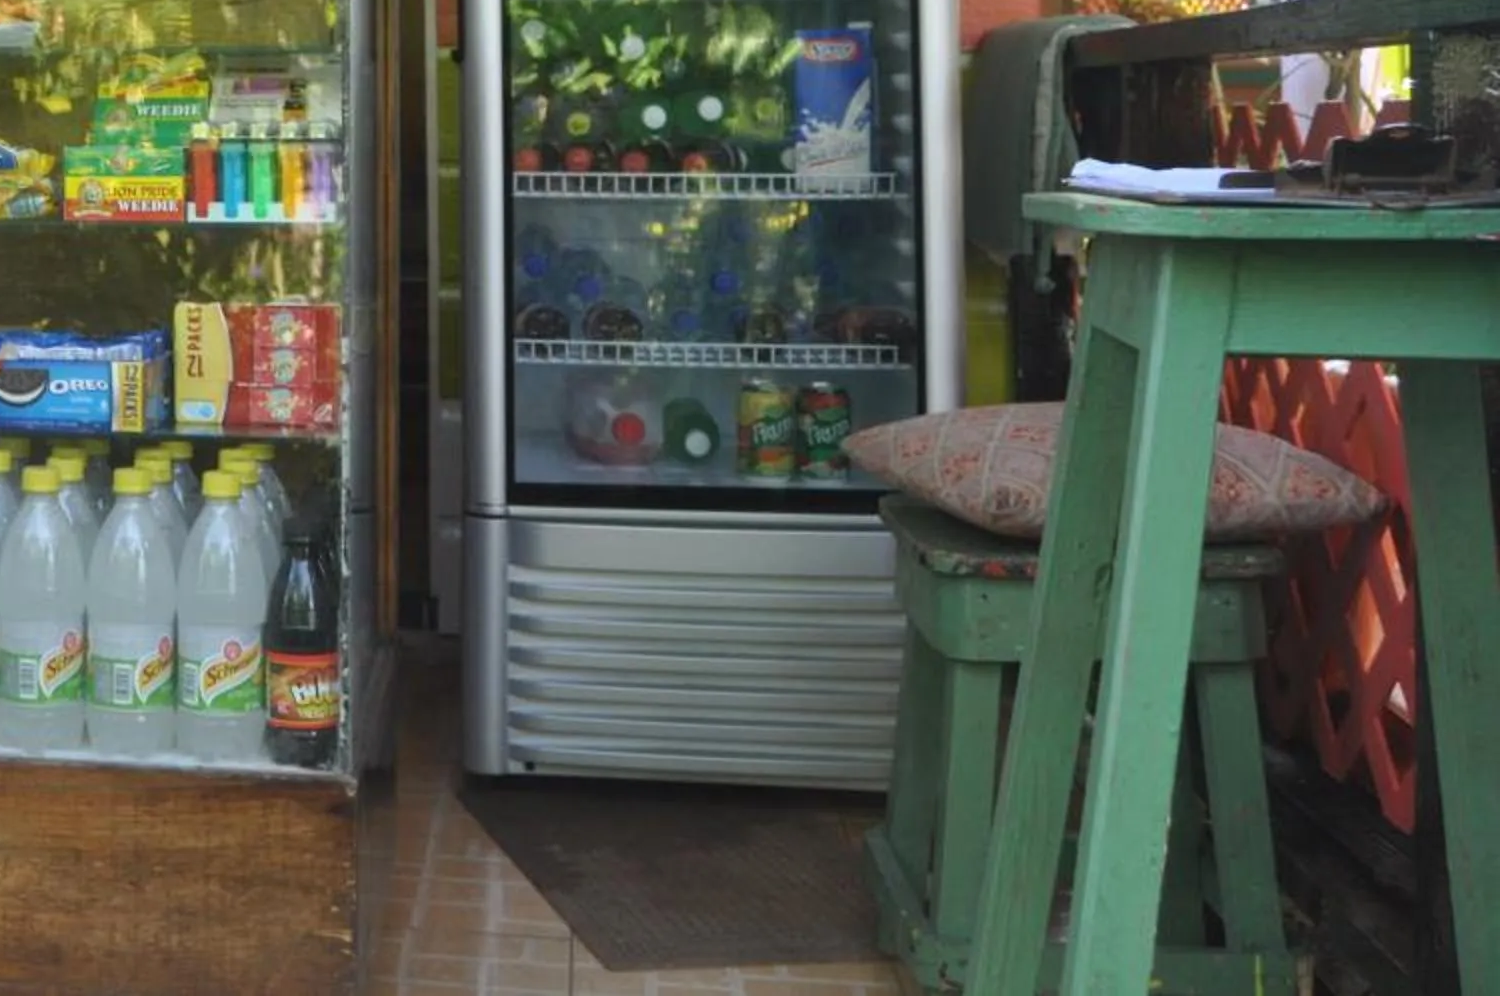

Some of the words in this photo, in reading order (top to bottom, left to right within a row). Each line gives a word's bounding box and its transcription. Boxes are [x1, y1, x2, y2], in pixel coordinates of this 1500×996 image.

[117, 199, 179, 213] WEEDIE
[186, 306, 203, 351] PACKS
[49, 379, 109, 395] OREO
